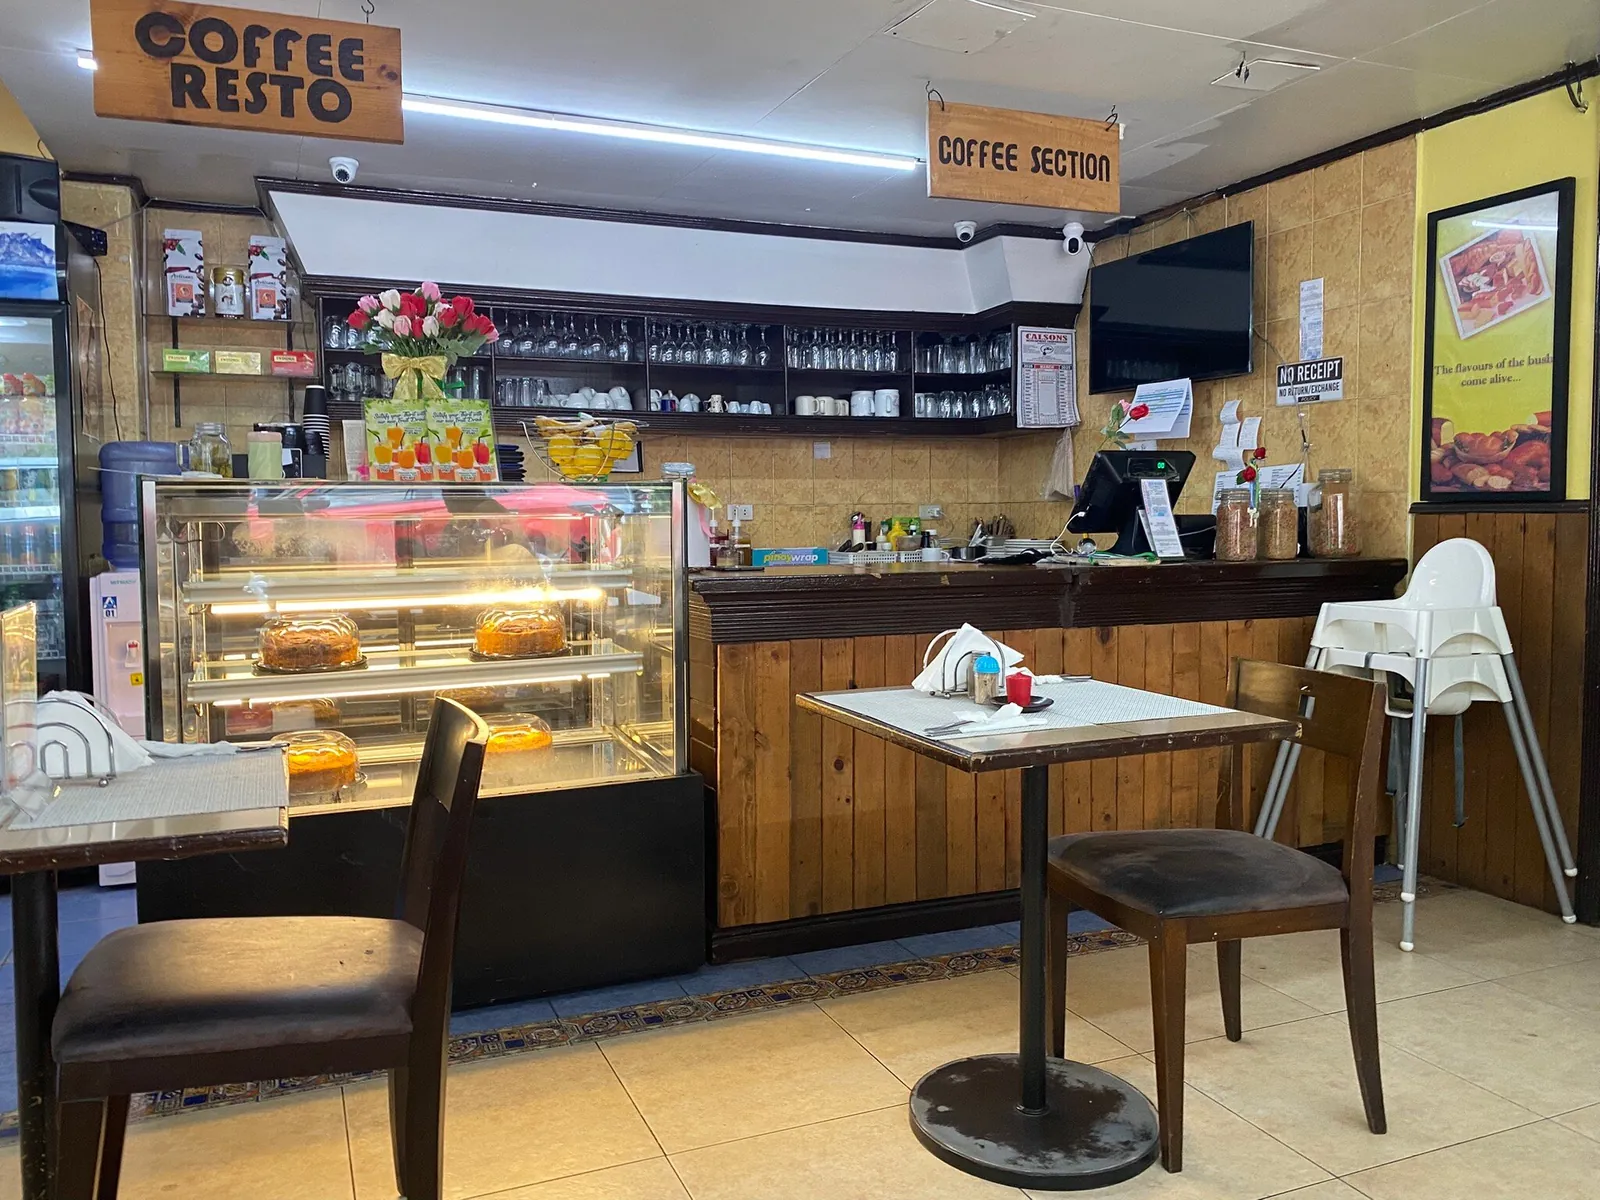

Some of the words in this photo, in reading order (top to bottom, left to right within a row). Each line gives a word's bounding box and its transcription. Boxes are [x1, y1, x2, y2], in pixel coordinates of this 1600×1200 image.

[135, 11, 364, 81] COFFEE
[171, 63, 352, 123] RESTO
[938, 135, 1018, 172] COFFEE
[1031, 145, 1110, 182] SECTION
[1025, 333, 1068, 341] CALSONS
[1280, 367, 1294, 384] NO
[1297, 360, 1340, 382] RECEIPT
[1433, 365, 1453, 376] The
[1455, 363, 1494, 374] flavours
[1496, 358, 1507, 369] of
[1508, 357, 1525, 368] the
[1461, 377, 1487, 387] come
[1489, 374, 1521, 385] alive...
[1279, 388, 1287, 397] NO
[763, 552, 819, 564] pinoywrap
[105, 609, 115, 618] 01
